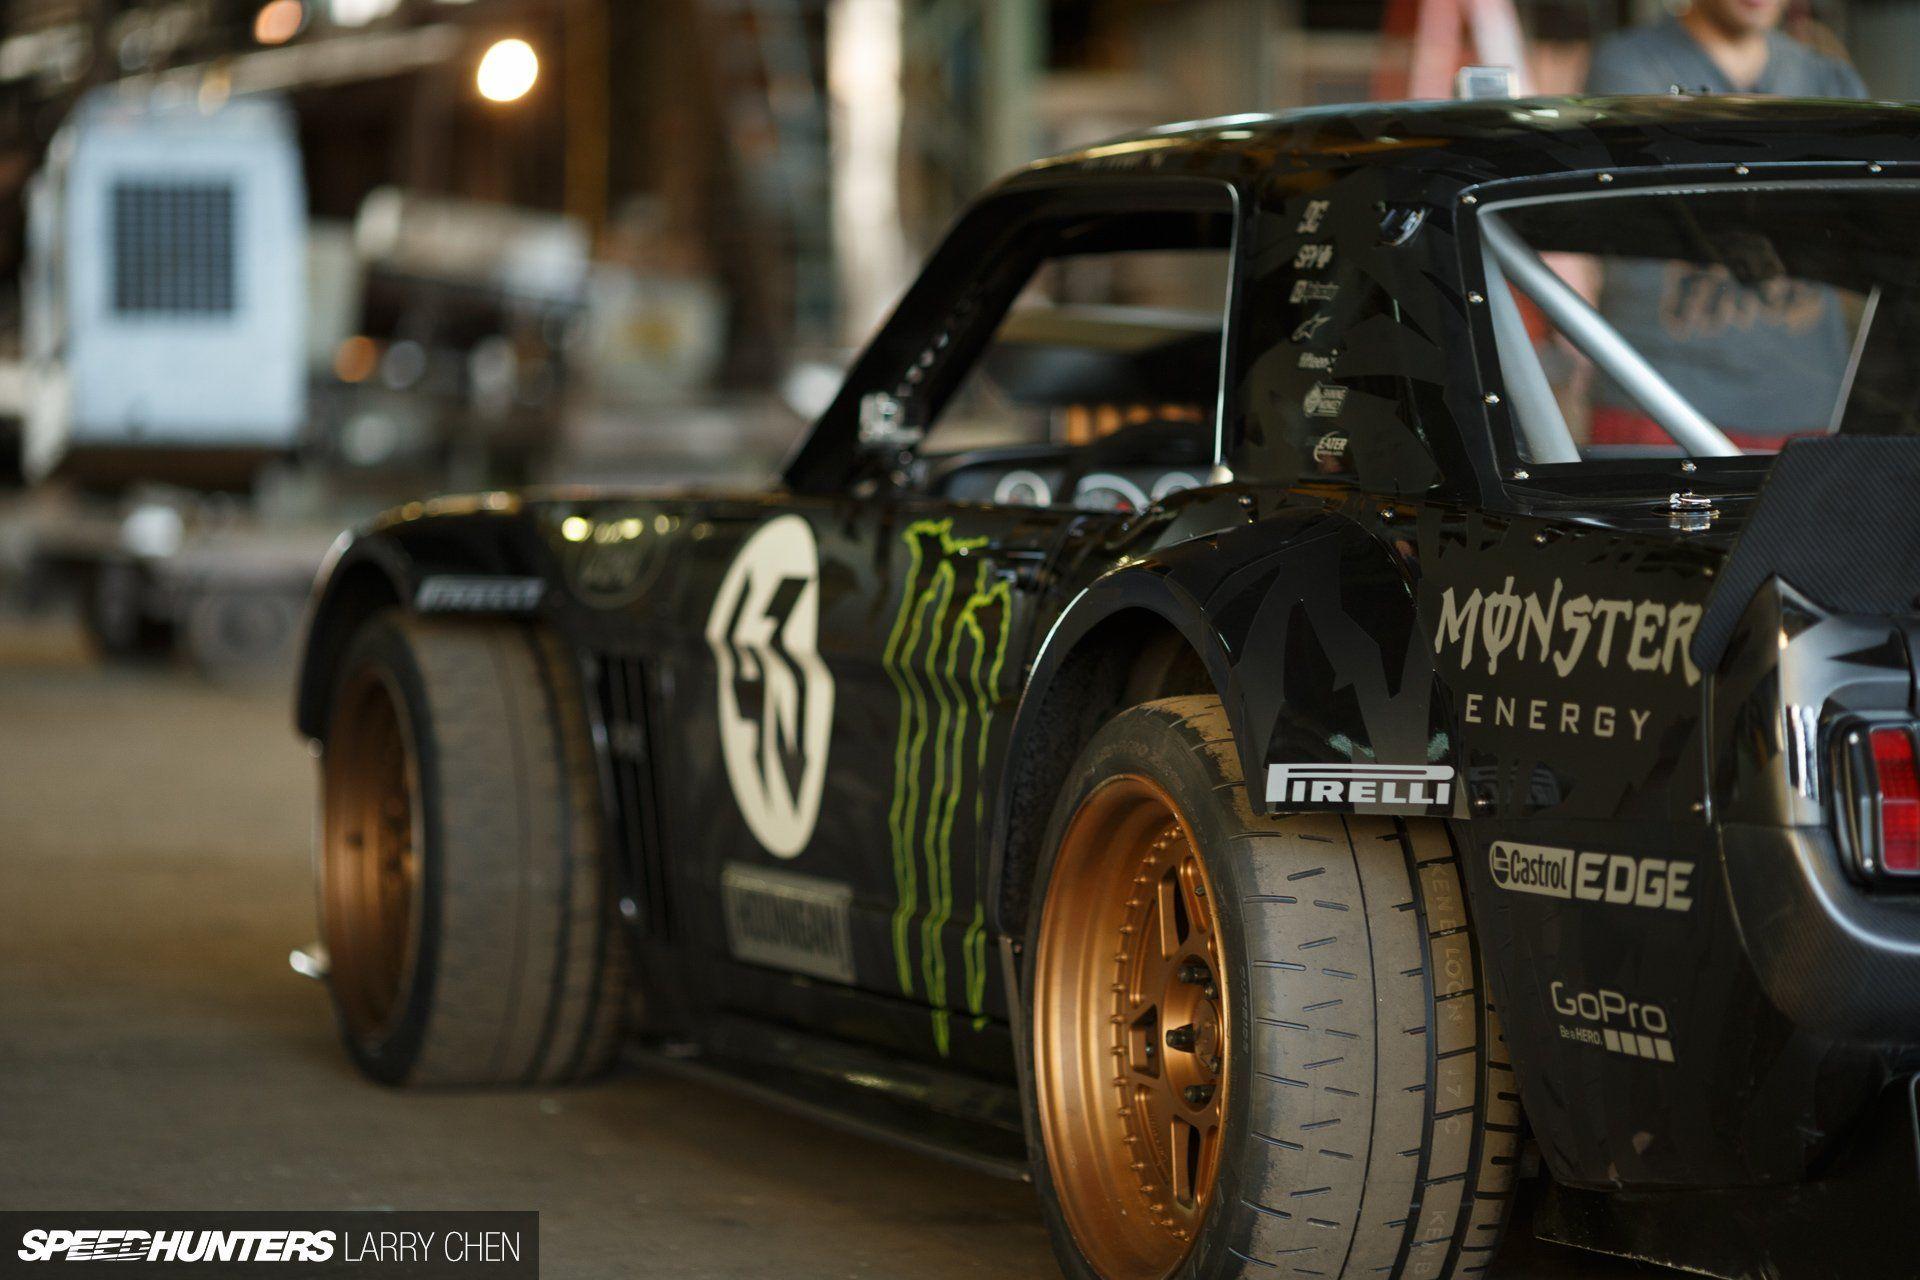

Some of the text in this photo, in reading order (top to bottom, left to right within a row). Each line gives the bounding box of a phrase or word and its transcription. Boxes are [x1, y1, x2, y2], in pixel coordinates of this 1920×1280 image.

[1434, 576, 1702, 687] MONSTER
[1465, 694, 1651, 741] ENERGY
[1265, 763, 1455, 805] PIRELLI
[1510, 849, 1695, 911] Castrol EDGE
[1551, 981, 1668, 1034] GoPro
